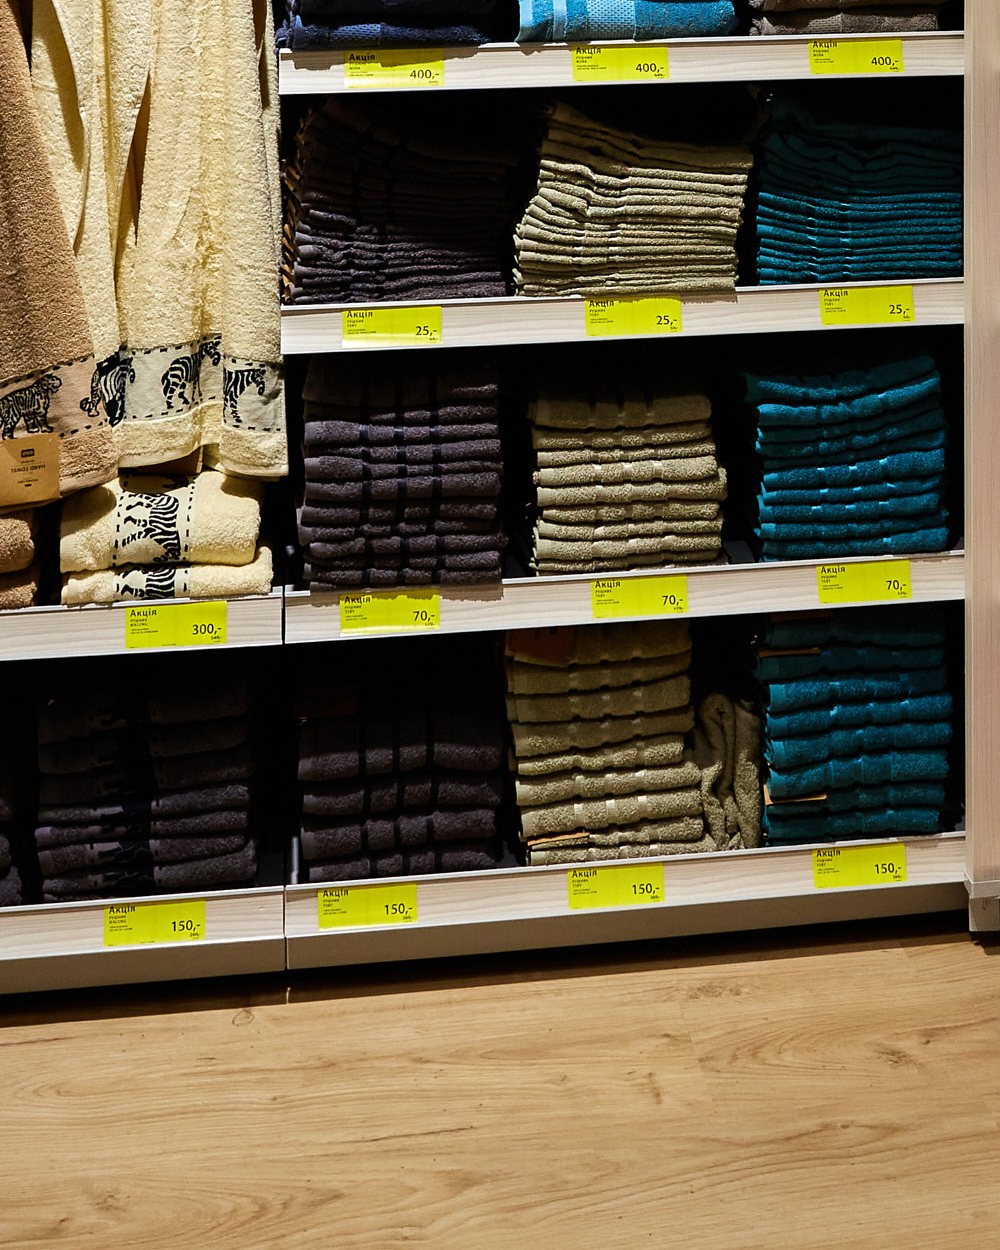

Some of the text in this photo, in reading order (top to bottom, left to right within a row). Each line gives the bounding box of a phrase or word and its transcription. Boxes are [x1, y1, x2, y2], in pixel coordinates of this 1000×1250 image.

[812, 40, 838, 49] Акція
[575, 46, 602, 56] Акція
[349, 53, 376, 62] Акція
[871, 56, 899, 67] 400,-
[635, 62, 664, 73] 400,-
[409, 69, 440, 80] 400,-
[823, 288, 849, 298] Акція
[589, 299, 615, 309] Акція
[346, 310, 373, 319] Акція
[888, 304, 910, 316] 25,-
[656, 315, 678, 326] 25,-
[415, 325, 437, 337] 25,-
[820, 565, 846, 574] Акція
[595, 580, 621, 589] Акція
[886, 579, 907, 591] 70,-
[344, 595, 371, 605] Акція
[661, 594, 683, 607] 70,-
[130, 608, 157, 618] Акція
[412, 610, 435, 622] 70,-
[192, 623, 222, 636] 300,-
[816, 848, 841, 858] Акція
[572, 869, 598, 879] Акція
[874, 862, 902, 875] 150,-
[322, 889, 349, 898] Акція
[631, 883, 660, 895] 150,-
[108, 904, 136, 915] Акція
[384, 903, 413, 915] 150,-
[171, 919, 201, 933] 150,-
